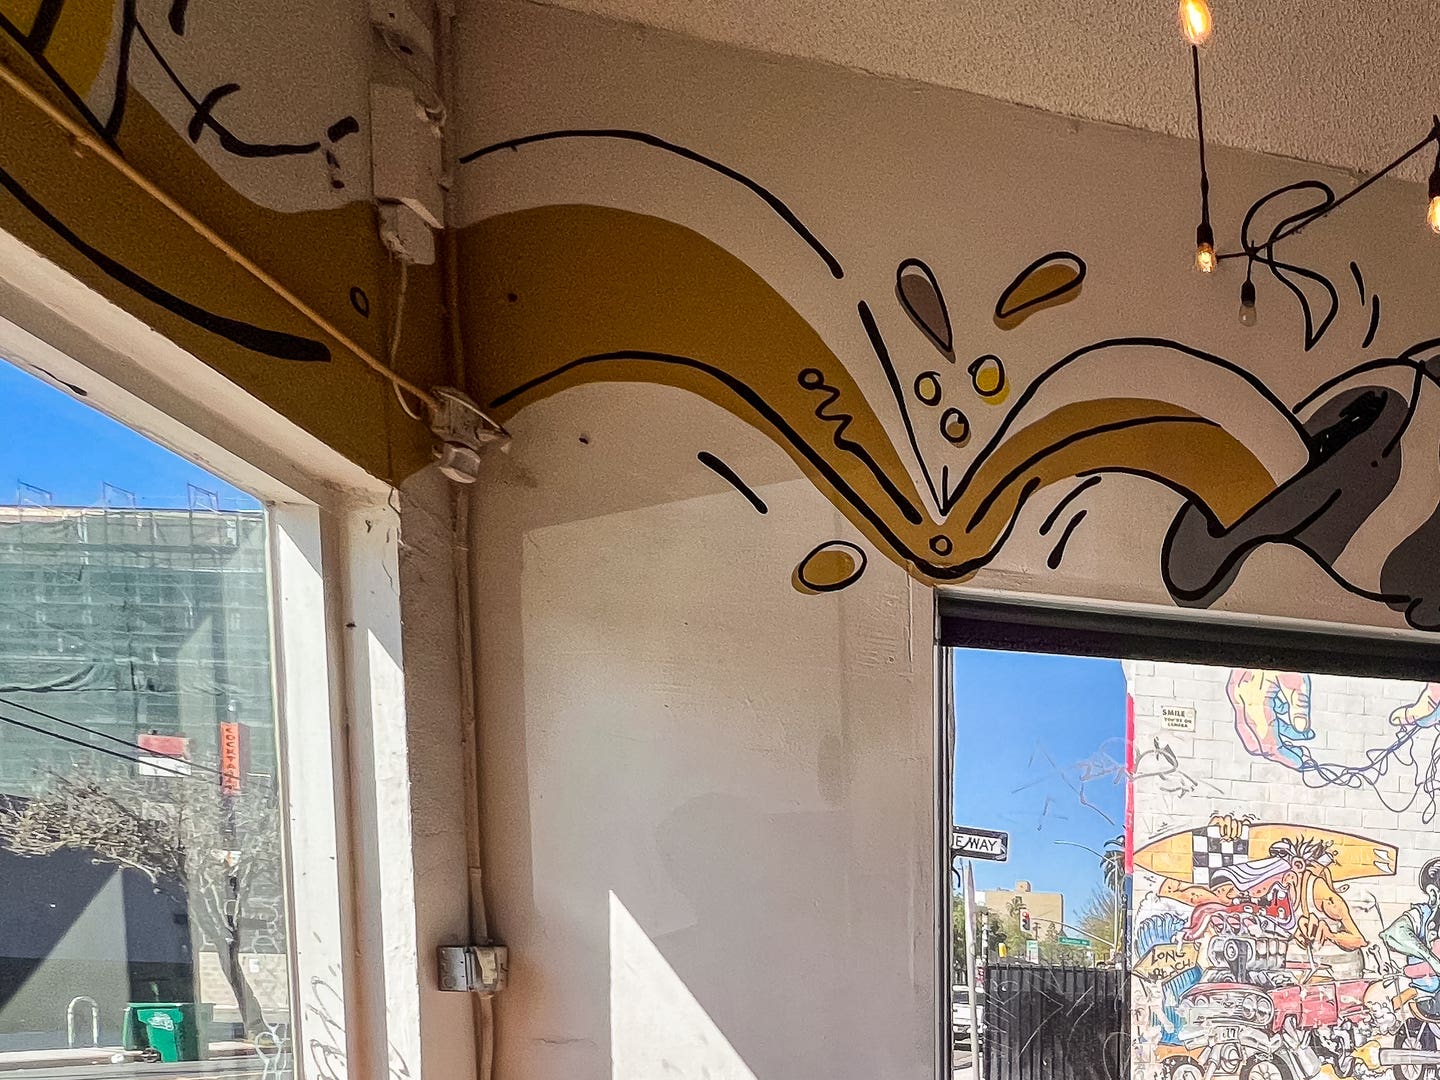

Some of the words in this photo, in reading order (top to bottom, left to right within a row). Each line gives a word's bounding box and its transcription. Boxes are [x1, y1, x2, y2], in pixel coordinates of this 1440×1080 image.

[1162, 709, 1186, 718] SMILE
[969, 837, 998, 852] WAY
[1151, 949, 1186, 966] LONG
